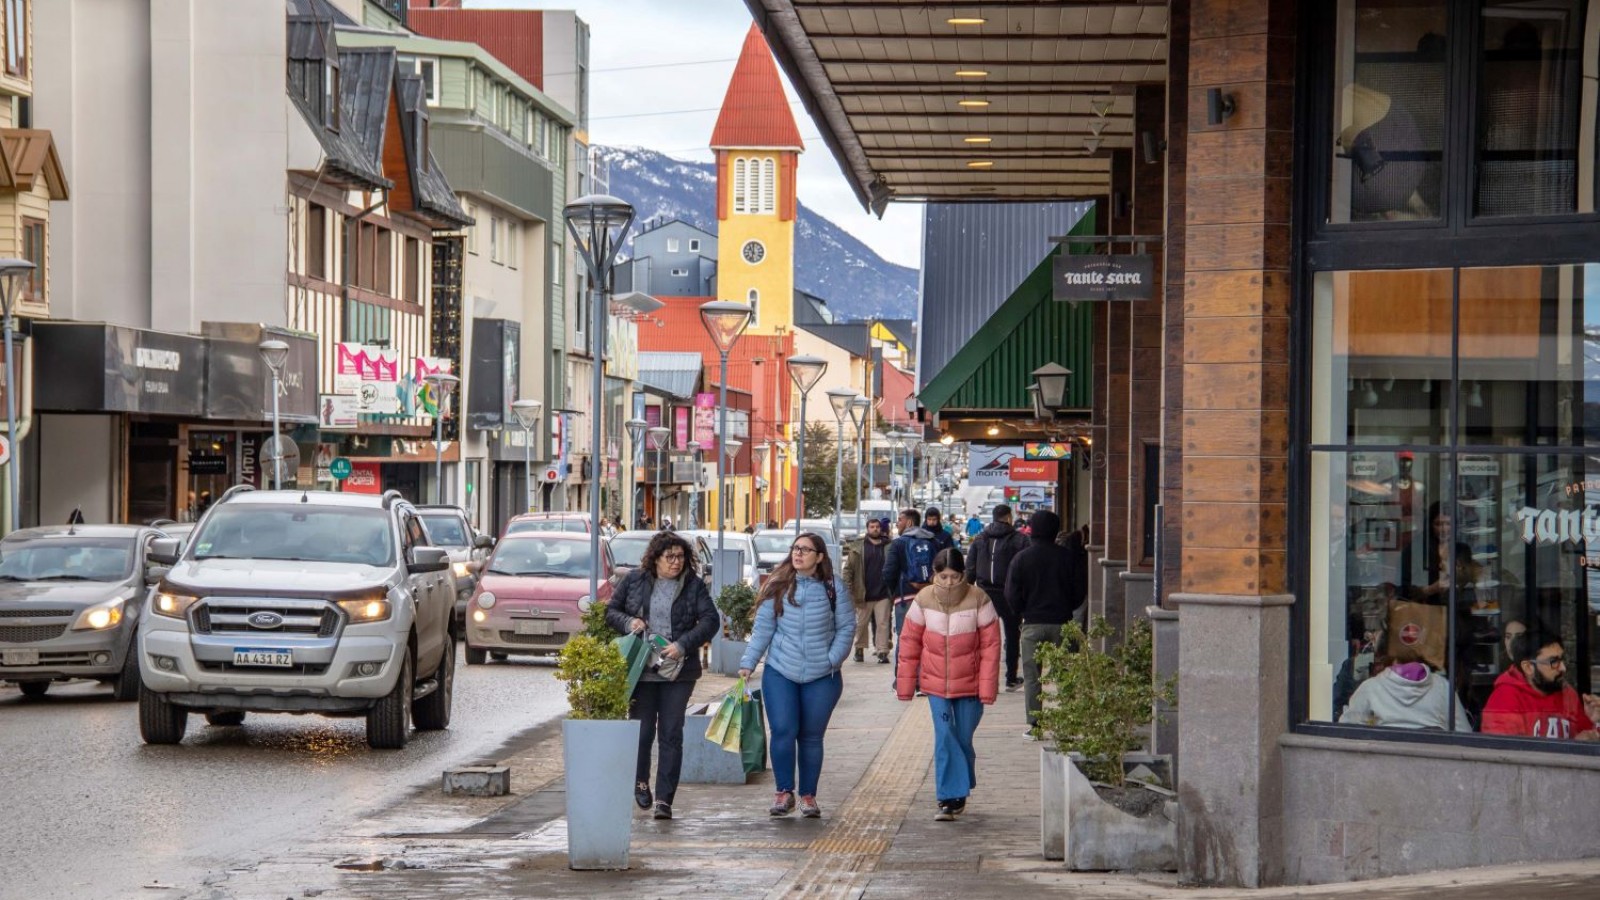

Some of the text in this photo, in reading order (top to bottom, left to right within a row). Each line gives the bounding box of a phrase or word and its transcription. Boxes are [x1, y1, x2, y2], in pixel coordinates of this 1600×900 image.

[1064, 270, 1104, 285] Tante
[255, 614, 274, 624] Ford
[236, 653, 289, 665] AA 431 RZ
